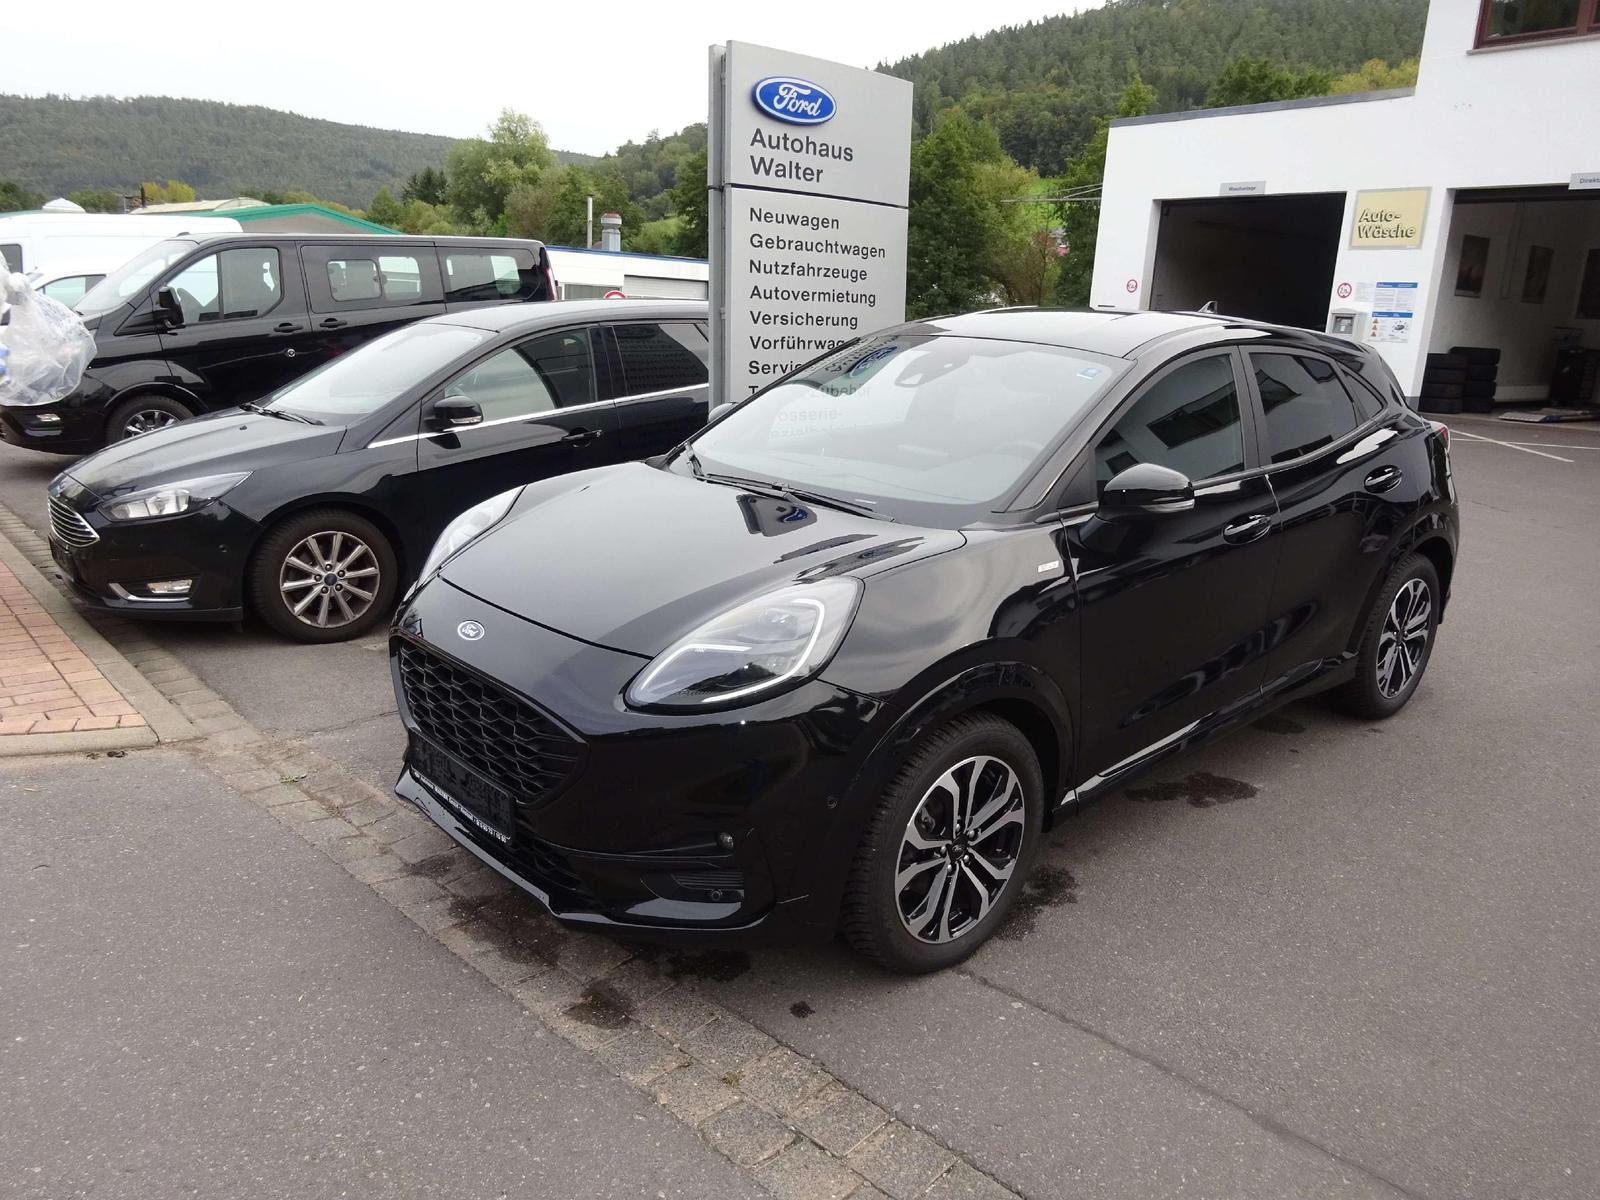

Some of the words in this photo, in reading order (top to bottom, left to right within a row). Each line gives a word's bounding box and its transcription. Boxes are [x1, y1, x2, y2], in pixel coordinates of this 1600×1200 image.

[773, 83, 823, 117] Ford
[750, 127, 854, 162] Autohaus
[750, 154, 824, 183] Walter
[750, 207, 840, 231] Neuwagen
[1358, 207, 1401, 224] Auto-
[1357, 223, 1416, 240] Wäsche
[749, 233, 887, 260] Gebrauchtwagen
[749, 259, 868, 283] Nutzfahrzeuge
[749, 285, 877, 308] Autovermietung
[749, 310, 859, 330] Versicherung
